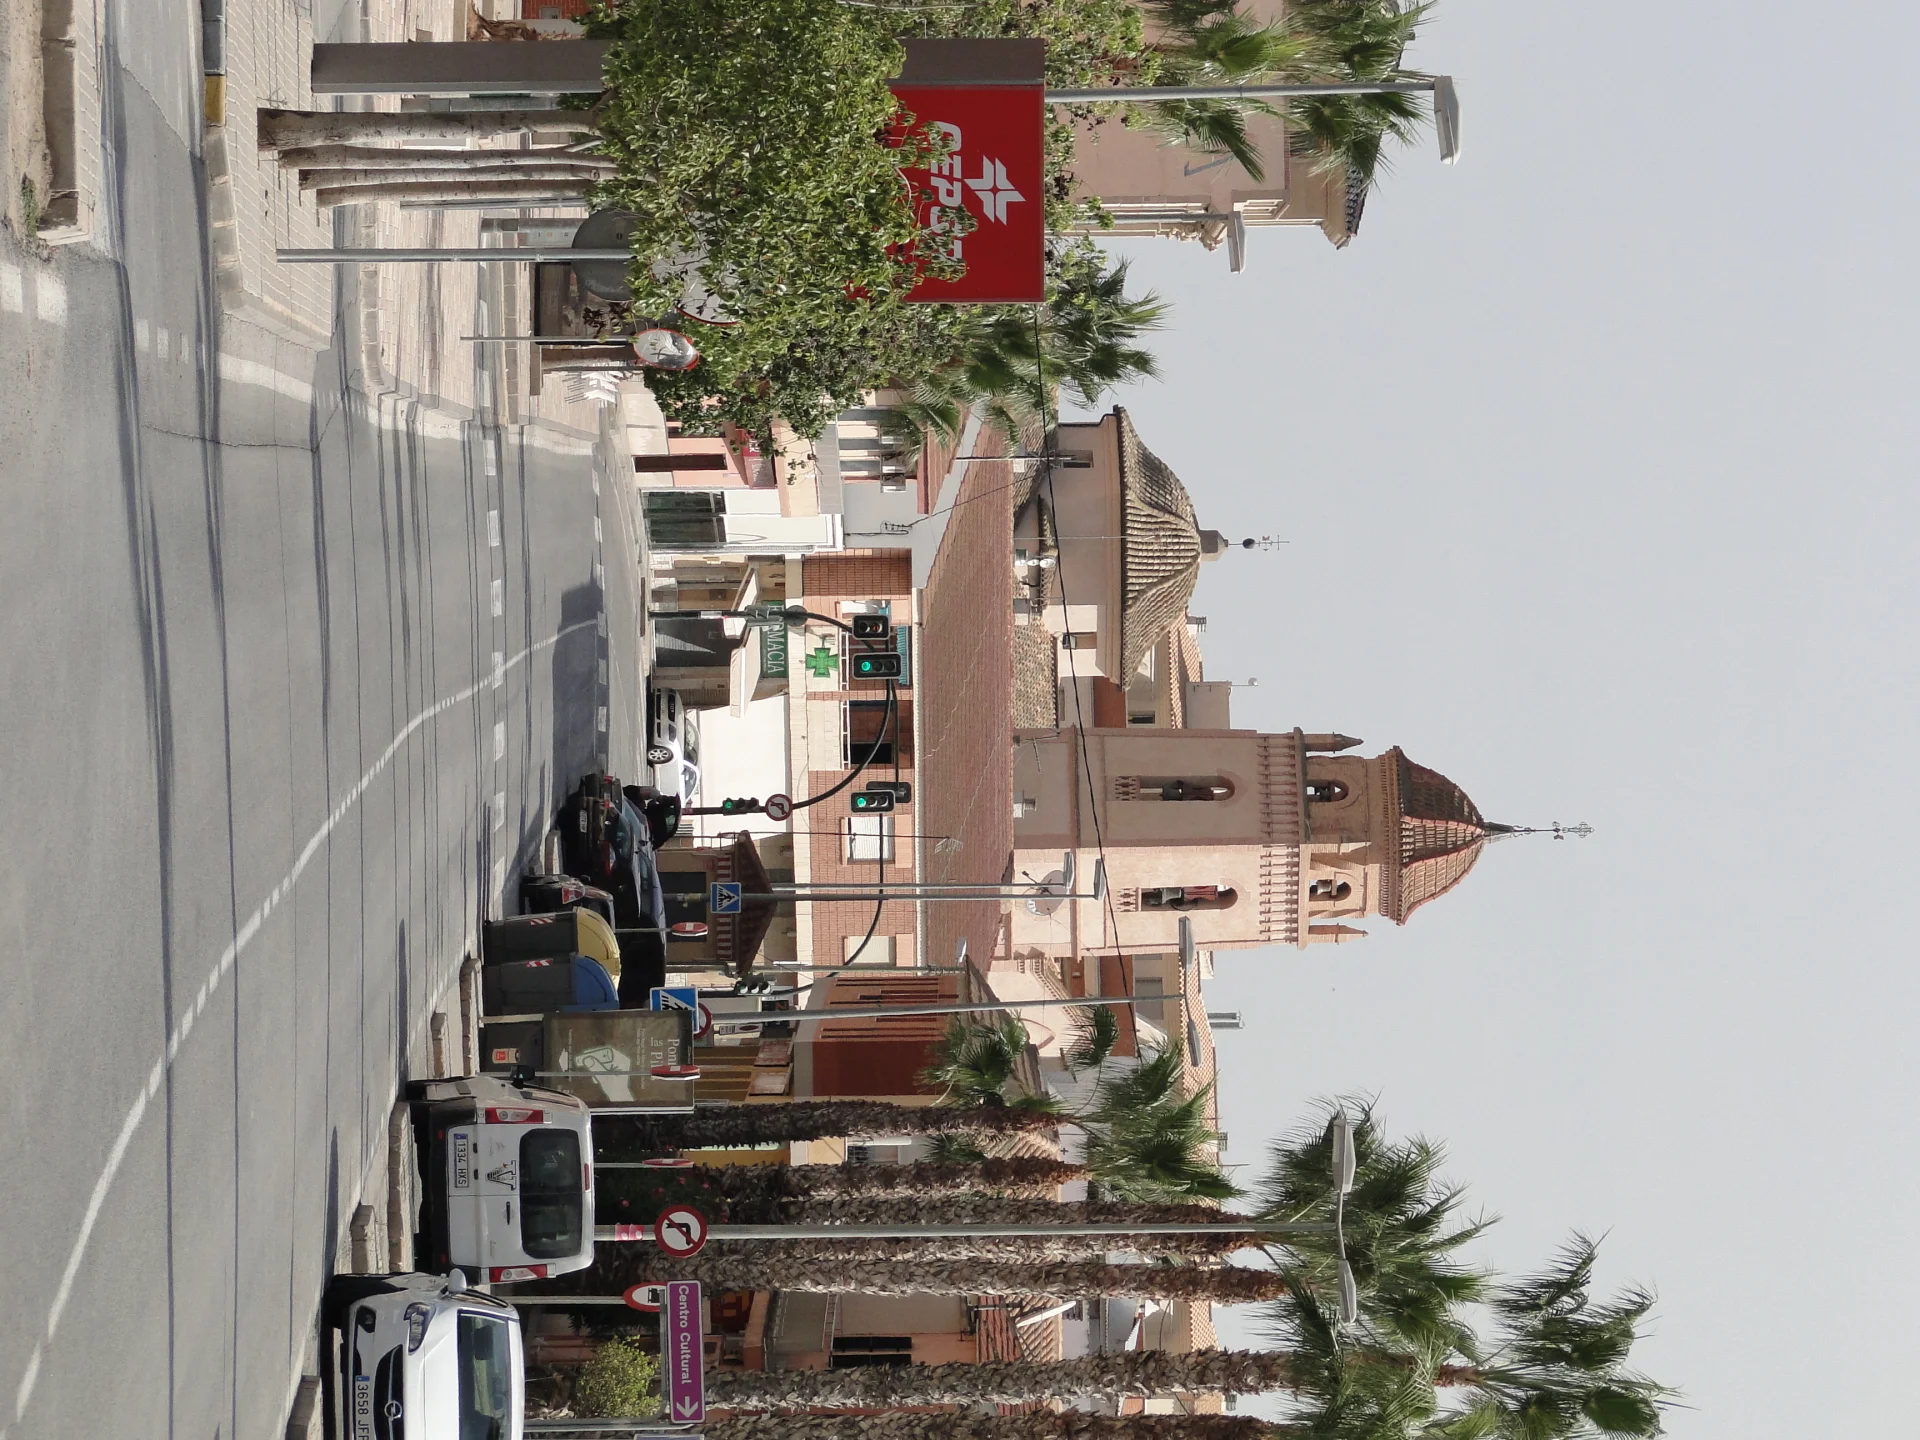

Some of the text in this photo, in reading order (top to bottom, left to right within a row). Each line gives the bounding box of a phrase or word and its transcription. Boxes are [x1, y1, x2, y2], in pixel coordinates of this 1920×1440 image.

[767, 605, 784, 673] FRMACIA
[457, 1142, 467, 1185] 1334 HXS
[678, 1285, 692, 1385] Centro Cultural
[357, 1384, 369, 1415] 3658
